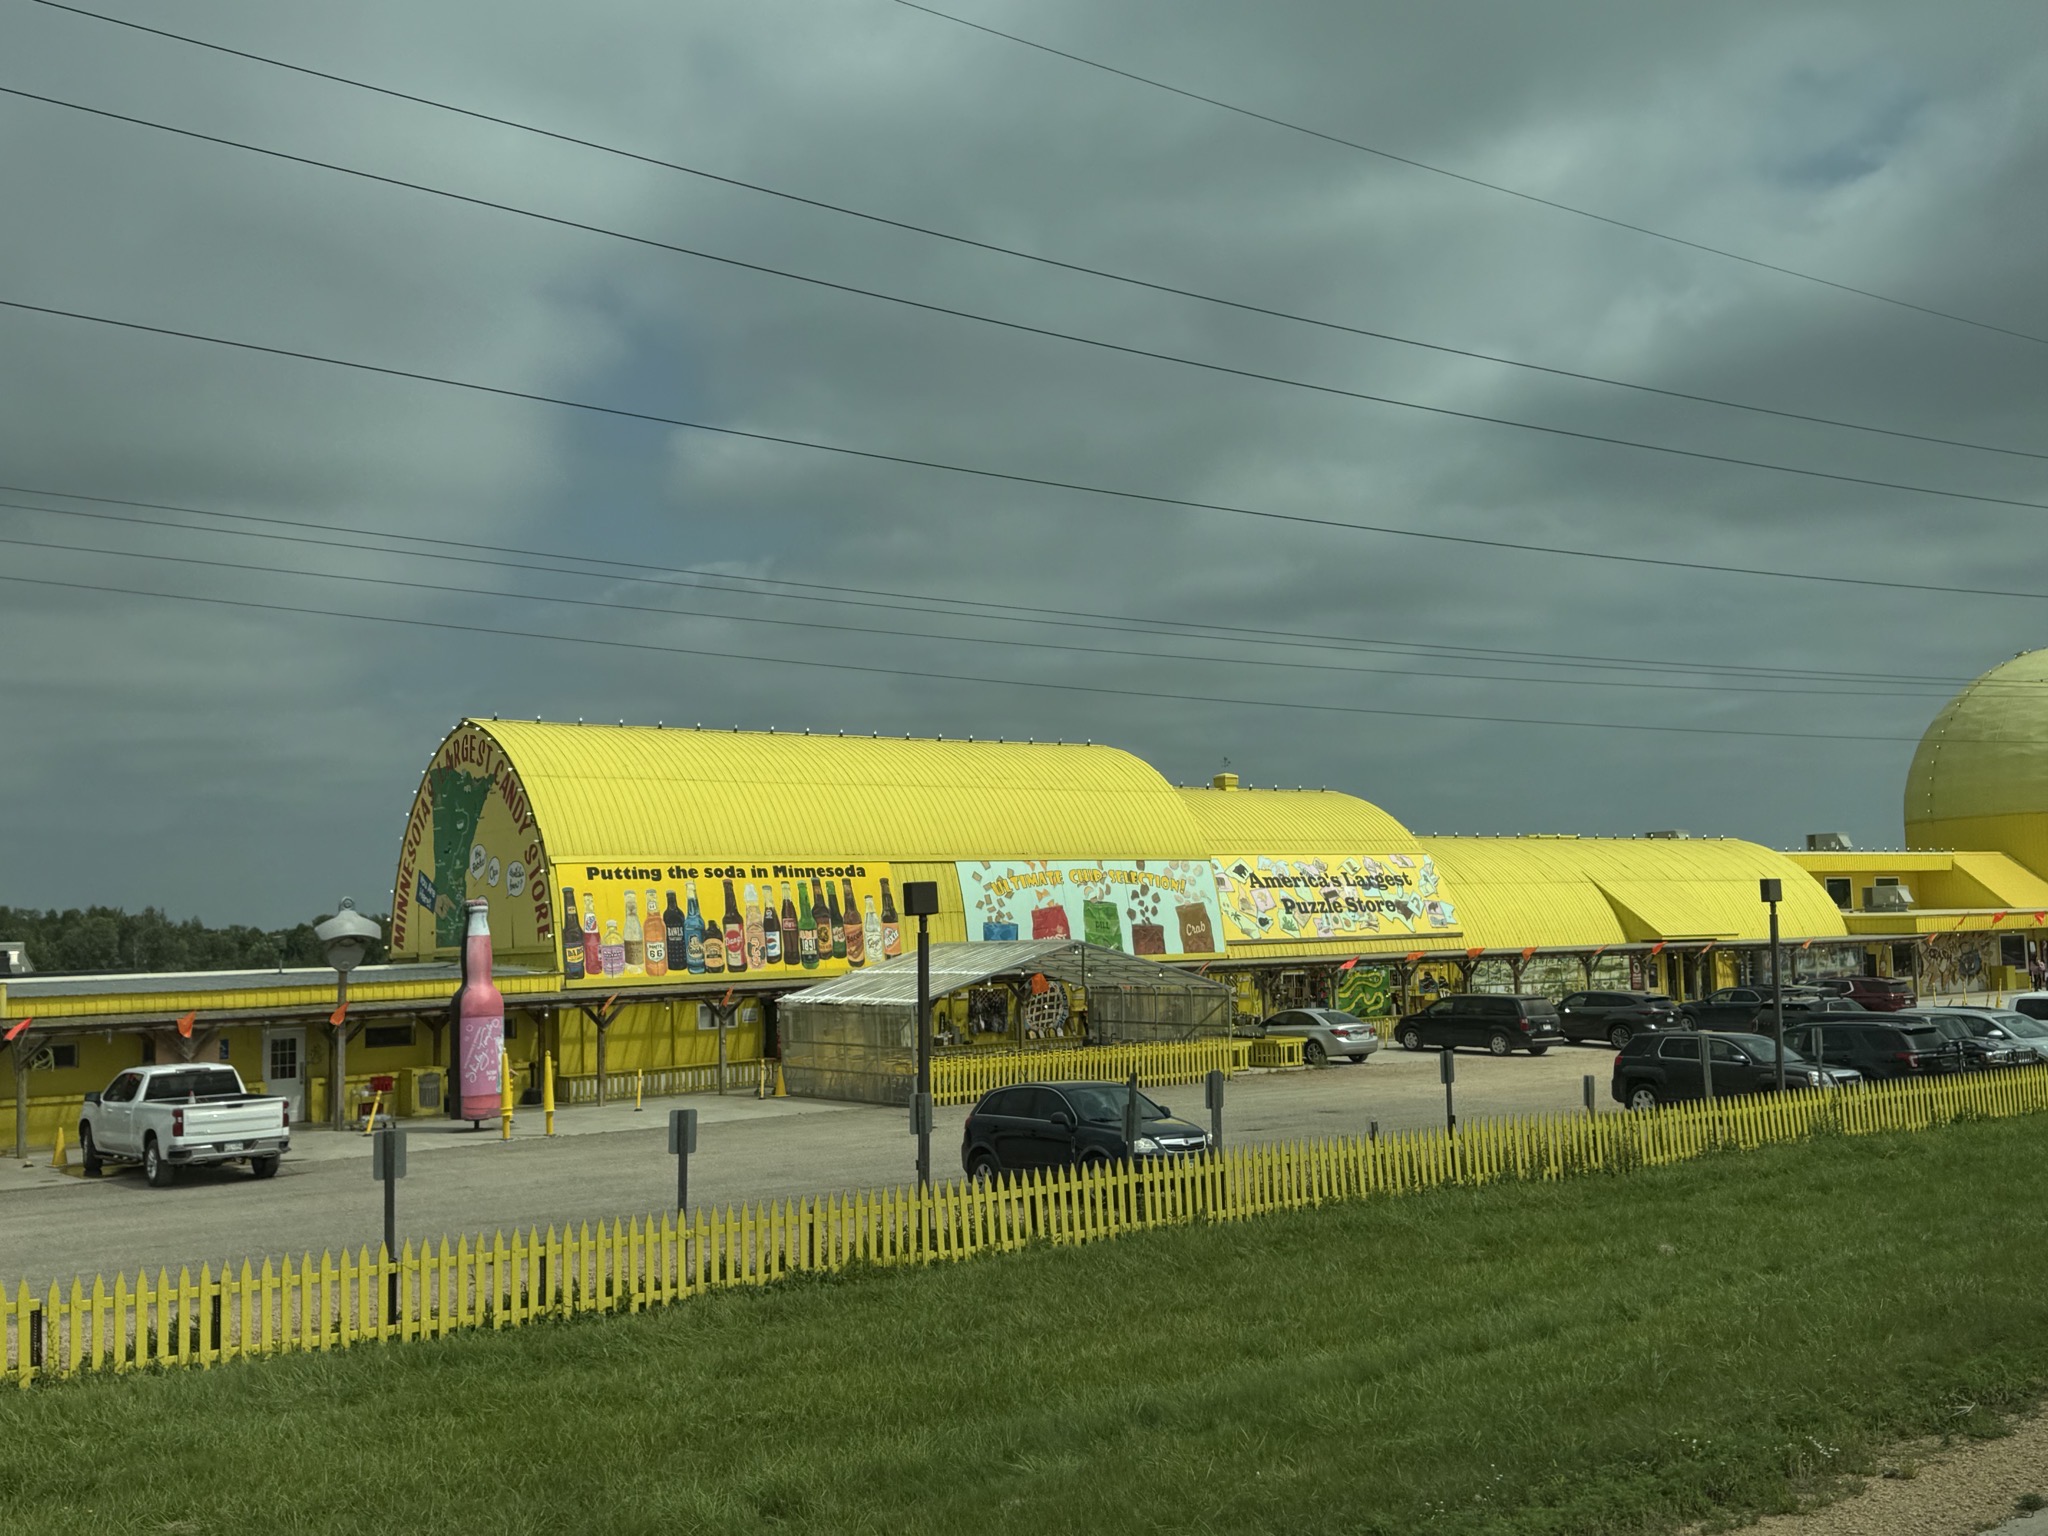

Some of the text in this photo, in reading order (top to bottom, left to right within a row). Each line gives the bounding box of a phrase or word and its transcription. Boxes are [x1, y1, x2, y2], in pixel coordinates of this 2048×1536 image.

[393, 734, 550, 950] MINNESOTA'S LARGEST CANDY STORE
[586, 865, 867, 881] Putting the soda in Minnesoda
[1249, 871, 1413, 890] America's Largest
[990, 870, 1065, 897] ULTIMATE
[1108, 869, 1187, 895] SELECTION!
[1281, 896, 1396, 915] Puzzle Store
[1095, 920, 1111, 930] DILL
[1185, 921, 1206, 937] Crab
[649, 949, 663, 958] 66
